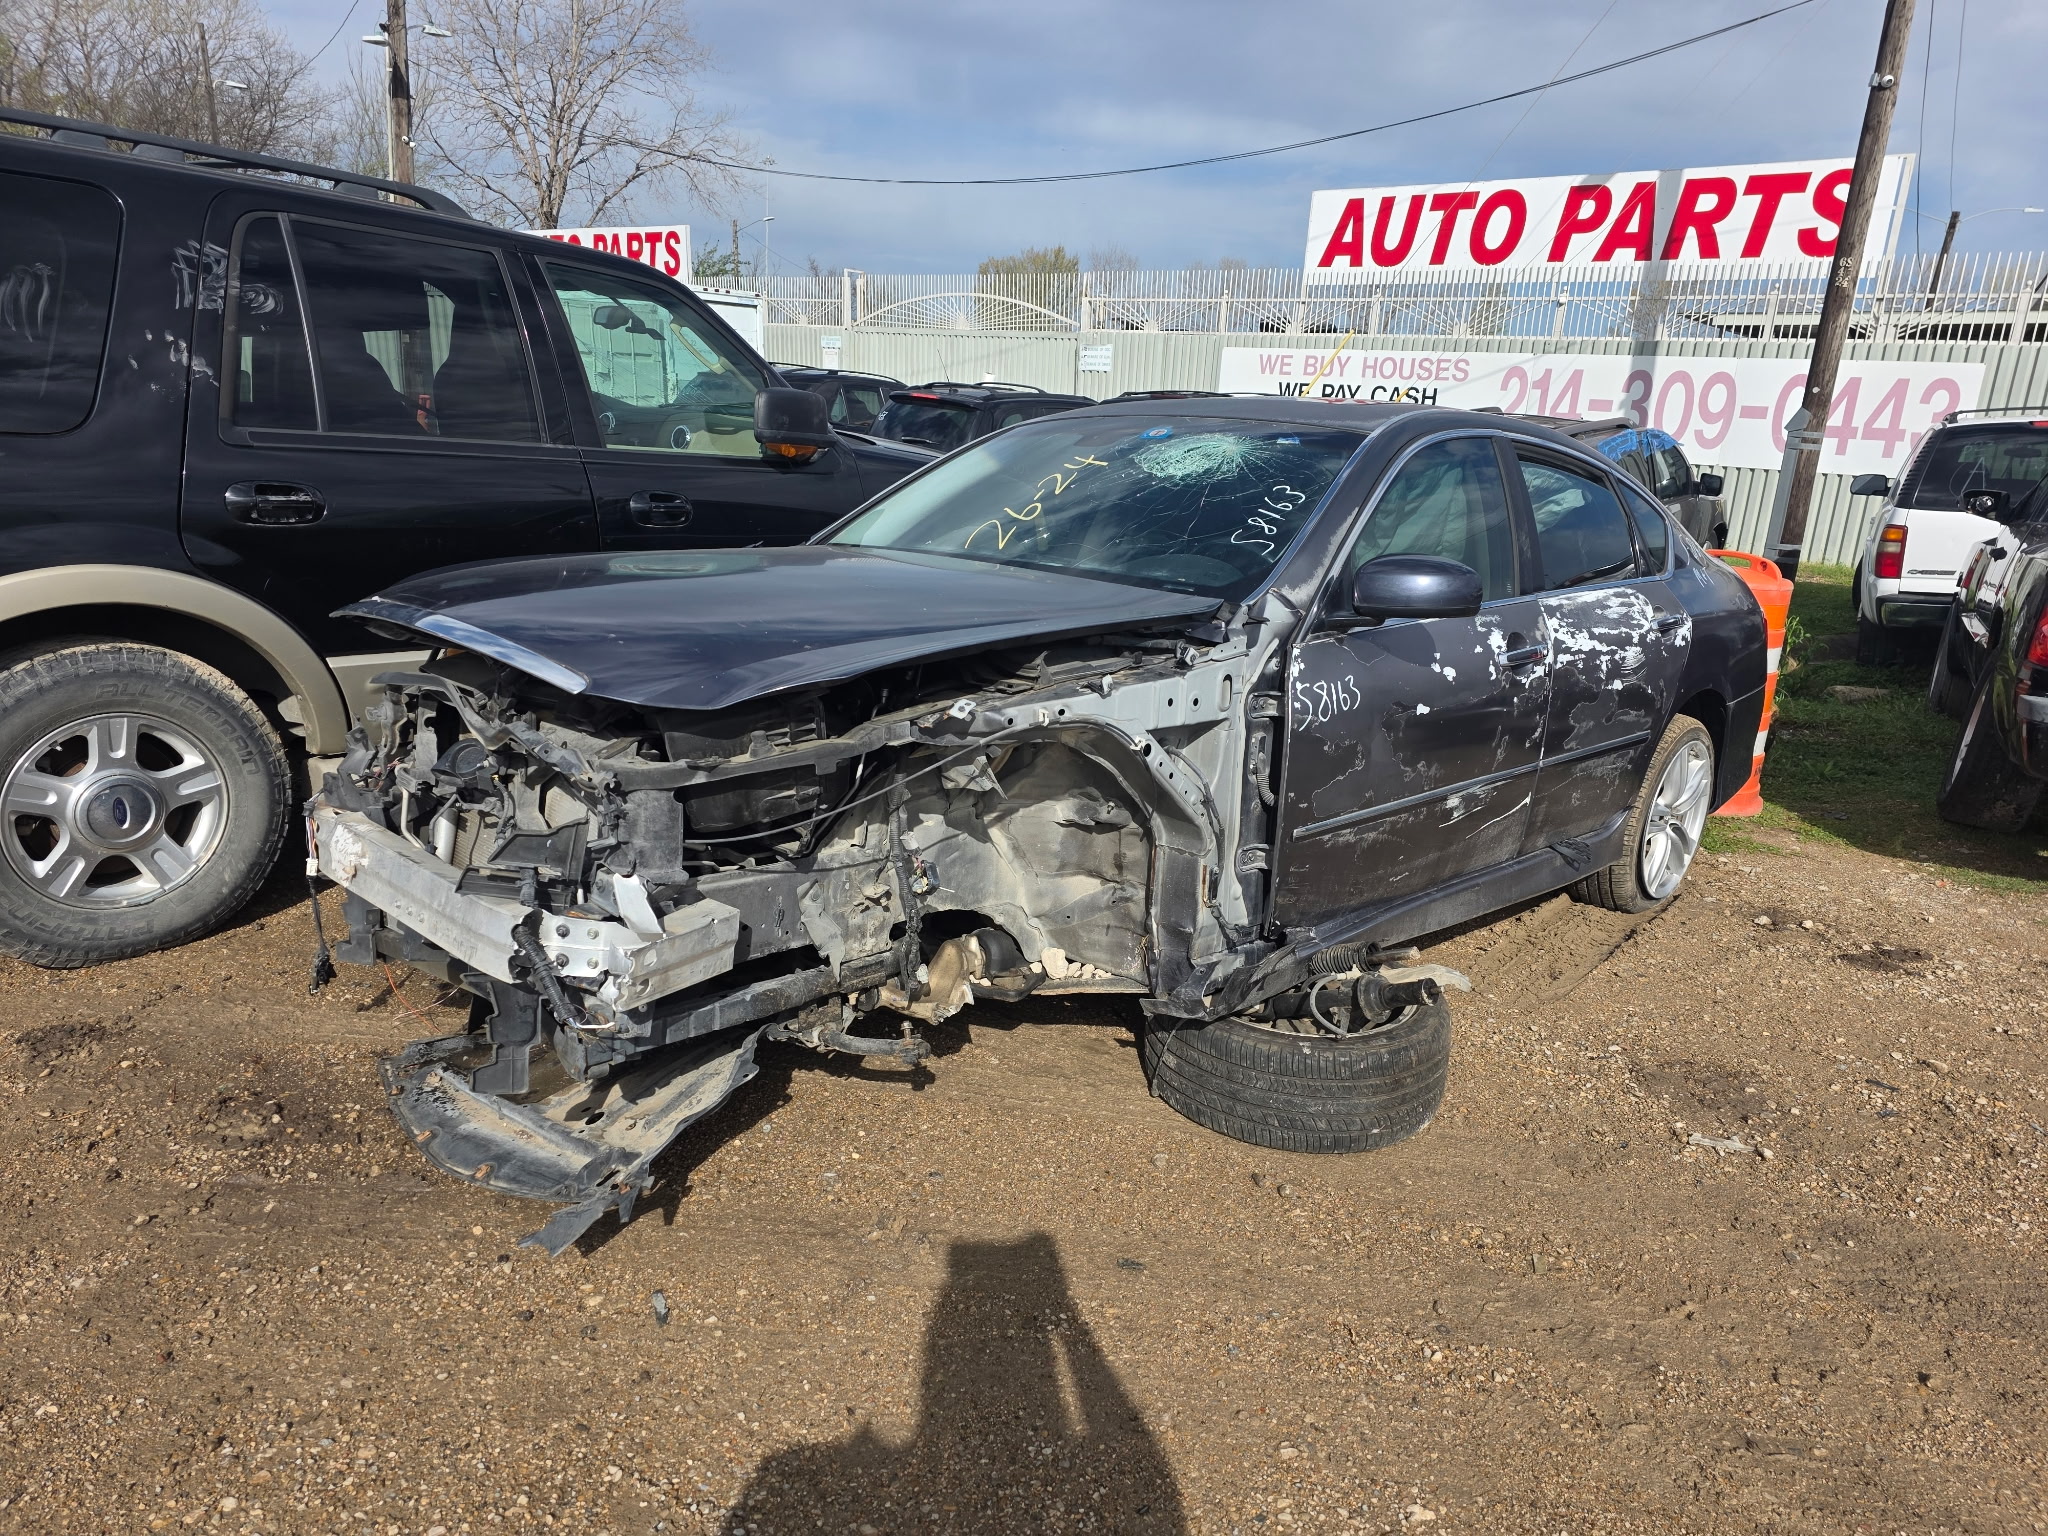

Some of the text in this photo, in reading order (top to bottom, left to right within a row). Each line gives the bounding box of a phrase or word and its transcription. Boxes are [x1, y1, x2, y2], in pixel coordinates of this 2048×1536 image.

[1316, 168, 1854, 267] AUTO PARTS
[1259, 354, 1471, 383] WE BUY HOUSES
[1321, 384, 1362, 400] PAY
[1370, 385, 1438, 406] CASH
[964, 454, 1109, 550] 26-24
[1230, 485, 1306, 556] 58163
[1295, 675, 1361, 732] 58163
